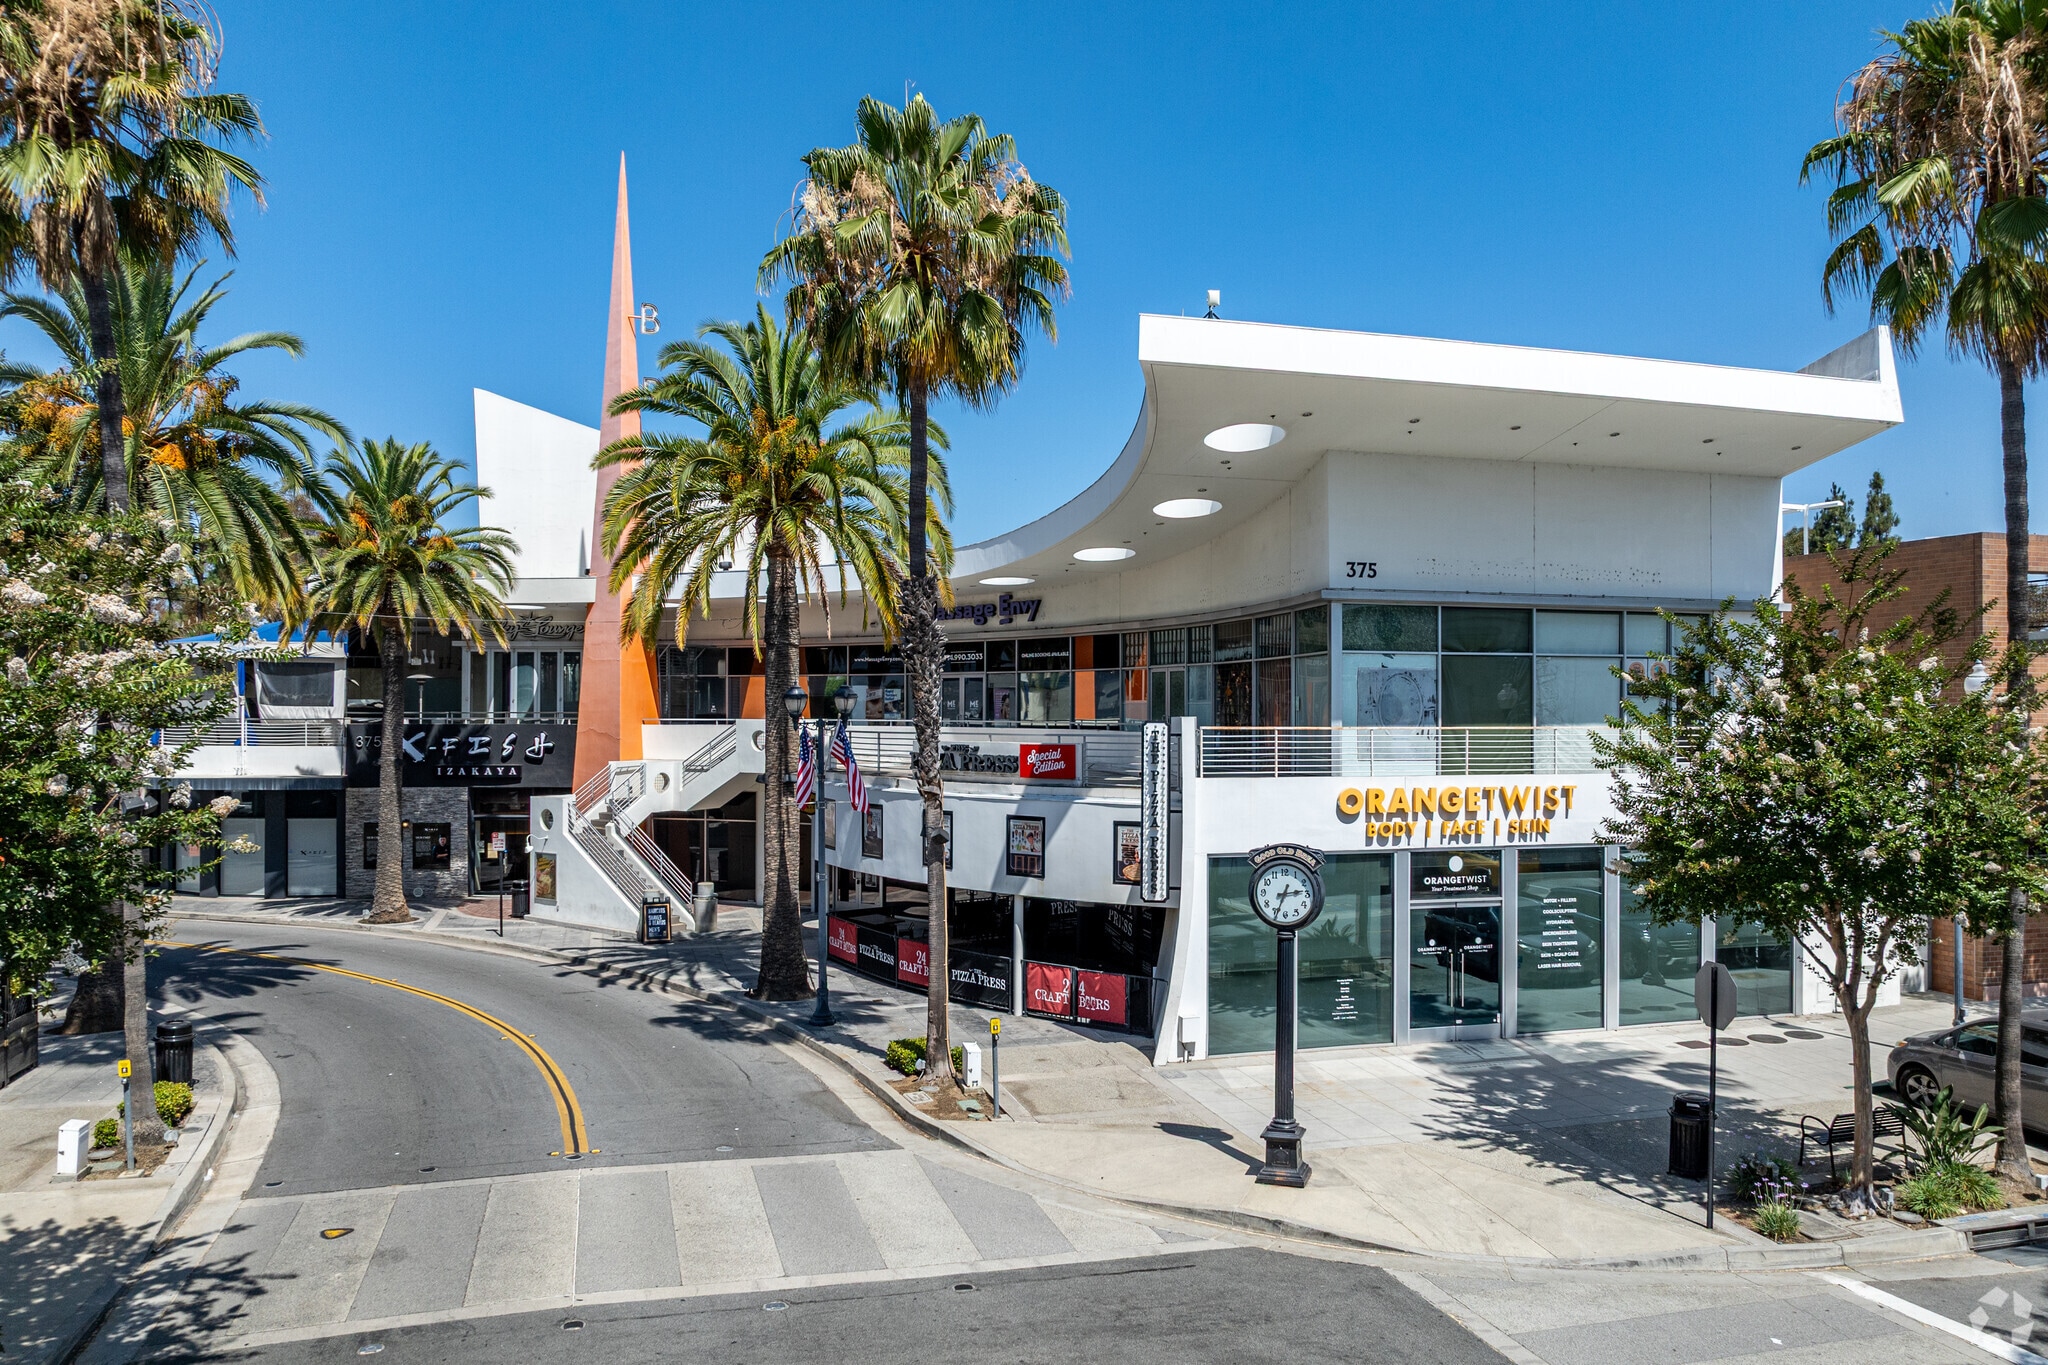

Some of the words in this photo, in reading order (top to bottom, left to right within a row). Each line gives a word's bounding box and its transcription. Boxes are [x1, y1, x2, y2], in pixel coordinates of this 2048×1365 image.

[1346, 562, 1377, 578] 375
[935, 604, 995, 625] assage
[999, 594, 1040, 625] Envy
[356, 735, 382, 748] 375
[1151, 730, 1160, 765] THE
[959, 754, 1019, 773] PRESS
[1027, 748, 1062, 766] Special
[437, 767, 518, 776] IZAKAYA
[1033, 759, 1066, 775] Edition
[1150, 771, 1160, 827] PIZZA
[1337, 785, 1578, 815] ORANGETWIST
[1366, 820, 1418, 838] BODY
[1441, 819, 1486, 836] FACE
[1508, 818, 1551, 834] SKIN
[1276, 846, 1295, 856] OLD
[1150, 836, 1160, 895] PRESS
[1281, 868, 1289, 877] 12
[1263, 878, 1272, 887] 10
[1272, 871, 1278, 879] 11
[1294, 871, 1298, 879] 1
[1423, 875, 1488, 885] ORANGETWIST
[1301, 879, 1307, 887] 2
[1260, 888, 1267, 897] 9
[1304, 890, 1311, 899] 3
[1263, 899, 1270, 909] 8
[1301, 900, 1307, 909] 4
[1282, 910, 1289, 920] 6
[859, 943, 876, 959] PIZZA
[875, 949, 895, 966] PRESS
[916, 950, 927, 965] 24
[899, 959, 923, 975] CRAFT
[951, 969, 976, 985] PIZZA
[977, 973, 1006, 991] PRESS
[1034, 988, 1070, 1005] CRAFT
